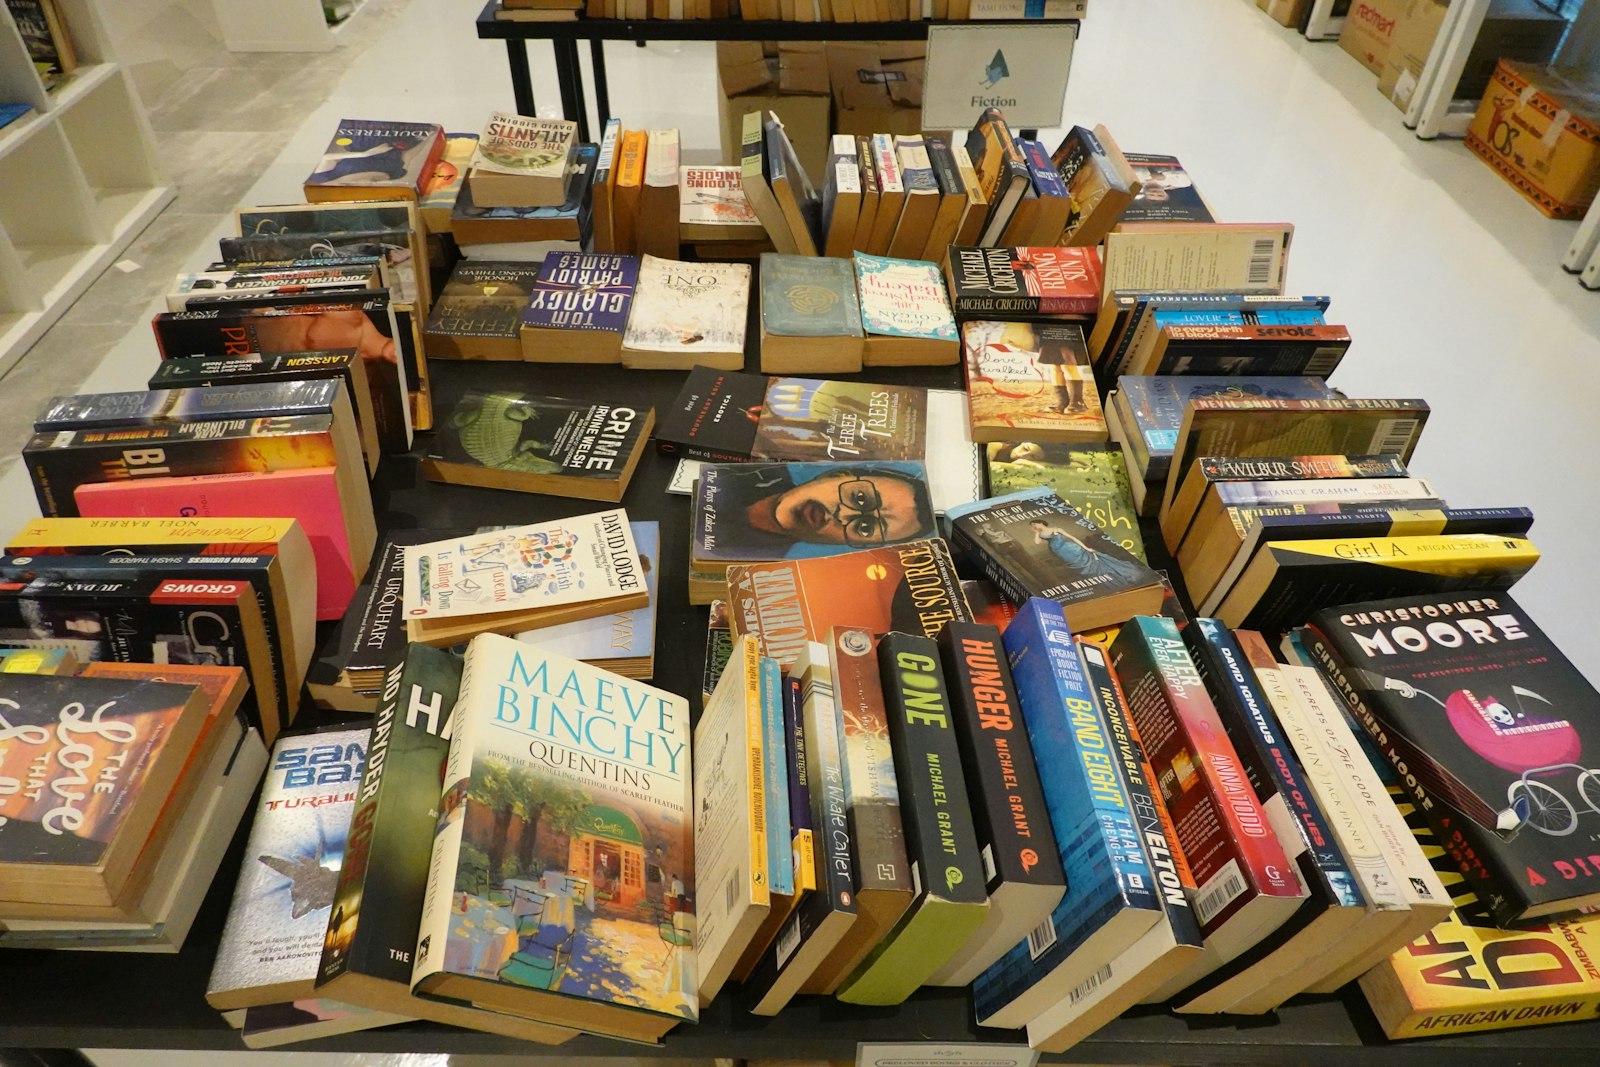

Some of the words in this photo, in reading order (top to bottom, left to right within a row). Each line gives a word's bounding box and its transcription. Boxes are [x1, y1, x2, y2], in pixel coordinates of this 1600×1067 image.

[970, 95, 1017, 109] Fiction
[493, 115, 539, 128] GIBBINS
[541, 121, 573, 131] DAVID
[338, 127, 432, 139] ADULTERESS
[488, 123, 571, 143] ATLANTIS
[490, 137, 504, 145] OF
[509, 139, 538, 149] GODS
[542, 141, 561, 150] THE
[559, 255, 621, 270] GAMES
[961, 249, 983, 290] MICHAEL
[987, 248, 1018, 294] CRICHTON
[1041, 251, 1067, 291] RISING
[1062, 259, 1088, 283] SUN
[235, 278, 298, 289] FRANZEN
[300, 274, 366, 285] JONATHAN
[458, 269, 497, 278] THIEVES
[474, 273, 519, 282] HONOUR
[498, 269, 538, 278] AMONG
[548, 268, 624, 286] PATRIOT
[661, 274, 717, 286] ONE
[868, 275, 938, 296] Bakery
[531, 291, 625, 313] CLANCY
[959, 298, 995, 311] MICHAEL
[996, 298, 1038, 311] CRICHTON
[550, 310, 594, 326] TOM
[878, 309, 942, 322] COLGAN
[1184, 315, 1220, 323] LOVER
[1182, 326, 1214, 335] every
[1215, 325, 1243, 333] birth
[287, 354, 349, 367] LARSSON
[979, 353, 1022, 364] love
[981, 365, 1032, 376] walked
[1002, 376, 1024, 384] in
[713, 394, 732, 423] EROTICA
[1198, 399, 1248, 409] NEVIL
[1249, 399, 1290, 409] SHUTE
[1301, 399, 1321, 409] ON
[1325, 399, 1351, 409] THE
[1357, 399, 1401, 409] BEACH
[585, 405, 610, 437] IRVINE
[689, 396, 714, 437] SOUTHEAST
[859, 391, 892, 440] TREES
[108, 431, 152, 441] BURNING
[179, 420, 246, 433] BILLINGHAM
[193, 427, 224, 439] MARK
[820, 413, 860, 459] THREE
[586, 407, 636, 471] CRIME
[569, 434, 592, 470] WELSH
[1227, 462, 1291, 477] WILBUR
[1292, 460, 1341, 476] SMITH
[1269, 488, 1306, 498] JANICE
[1310, 487, 1360, 497] GRAHAM
[90, 520, 150, 528] BARBER
[160, 520, 199, 528] NOEL
[969, 513, 988, 525] THE
[992, 509, 1011, 519] AGE
[1012, 505, 1024, 514] OF
[999, 507, 1054, 526] INNOCENCE
[1322, 513, 1353, 521] STARRY
[1354, 512, 1386, 520] NIGHTS
[548, 526, 563, 545] The
[601, 513, 626, 549] DAVID
[233, 556, 259, 564] SHOW
[437, 551, 452, 560] Is
[1334, 541, 1380, 560] Girl
[1391, 545, 1409, 557] A
[1416, 543, 1459, 552] ABIGAIL
[1461, 542, 1491, 551] DEAN
[431, 562, 454, 590] Falling
[610, 549, 639, 591] LODGE
[898, 545, 952, 608] SOURCE
[63, 584, 97, 592] DAN
[98, 583, 122, 592] JIU
[161, 583, 237, 594] CROWS
[1041, 583, 1071, 598] EDITH
[1072, 573, 1114, 590] WHARTON
[438, 590, 454, 610] Down
[367, 577, 403, 650] URQUHART
[1340, 598, 1501, 628] CHRISTOPHER
[1350, 613, 1530, 659] MOORE
[1050, 647, 1078, 661] EPIGRAM
[1161, 638, 1202, 687] AFTER
[1056, 659, 1078, 671] BOOKS
[1058, 669, 1084, 682] FICTION
[1149, 636, 1168, 665] EVER
[1161, 664, 1190, 700] HAPPY
[382, 660, 405, 703] MO
[1064, 681, 1084, 692] PRIZE
[506, 650, 676, 735] MAEVE
[494, 683, 687, 776] BINCHY
[1066, 697, 1105, 755] BAND
[1099, 686, 1143, 786] INCONCEIVABLE
[1312, 641, 1389, 749] CHRISTOPHER
[1387, 747, 1436, 812] MOORE
[961, 637, 1015, 732] HUNGER
[994, 737, 1019, 791] MICHAEL
[1008, 795, 1031, 839] GRANT
[1220, 646, 1245, 688] DAVID
[1240, 683, 1276, 746] IGNATIUS
[1270, 747, 1297, 788] BODY
[1291, 789, 1309, 813] OF
[1301, 812, 1327, 848] LIES
[1295, 677, 1329, 725] SECRETS
[1351, 774, 1378, 808] CODE
[360, 707, 396, 804] HAYDER
[896, 651, 948, 730] GONE
[926, 752, 940, 808] MICHAEL
[936, 811, 958, 856] GRANT
[1265, 671, 1289, 704] TIME
[1291, 725, 1324, 769] AGAIN
[1321, 779, 1343, 809] JACK
[1339, 809, 1368, 853] FINNEY
[41, 700, 138, 836] Love
[93, 749, 129, 795] THE
[528, 740, 652, 792] QUENTINS
[798, 750, 808, 786] DETECTIVES
[827, 764, 840, 785] The
[23, 751, 53, 803] THAT
[487, 749, 511, 764] FROM
[511, 756, 527, 768] THE
[528, 761, 577, 782] BESTSELLING
[577, 774, 608, 792] AUTHOR
[620, 788, 653, 804] SCARLET
[653, 797, 686, 813] FEATHER
[1084, 751, 1126, 808] EIGHT
[1208, 751, 1240, 799] ANNA
[1237, 794, 1268, 839] TODD
[827, 784, 847, 828] Whale
[1101, 814, 1125, 863] CHENG-E
[1115, 818, 1144, 865] THAM
[832, 829, 852, 882] Caller
[424, 837, 447, 920] QUENTINS
[1526, 865, 1547, 887] A
[389, 948, 411, 964] THE
[1415, 1007, 1517, 1030] AFRICAN
[1513, 1002, 1586, 1021] DAWN
